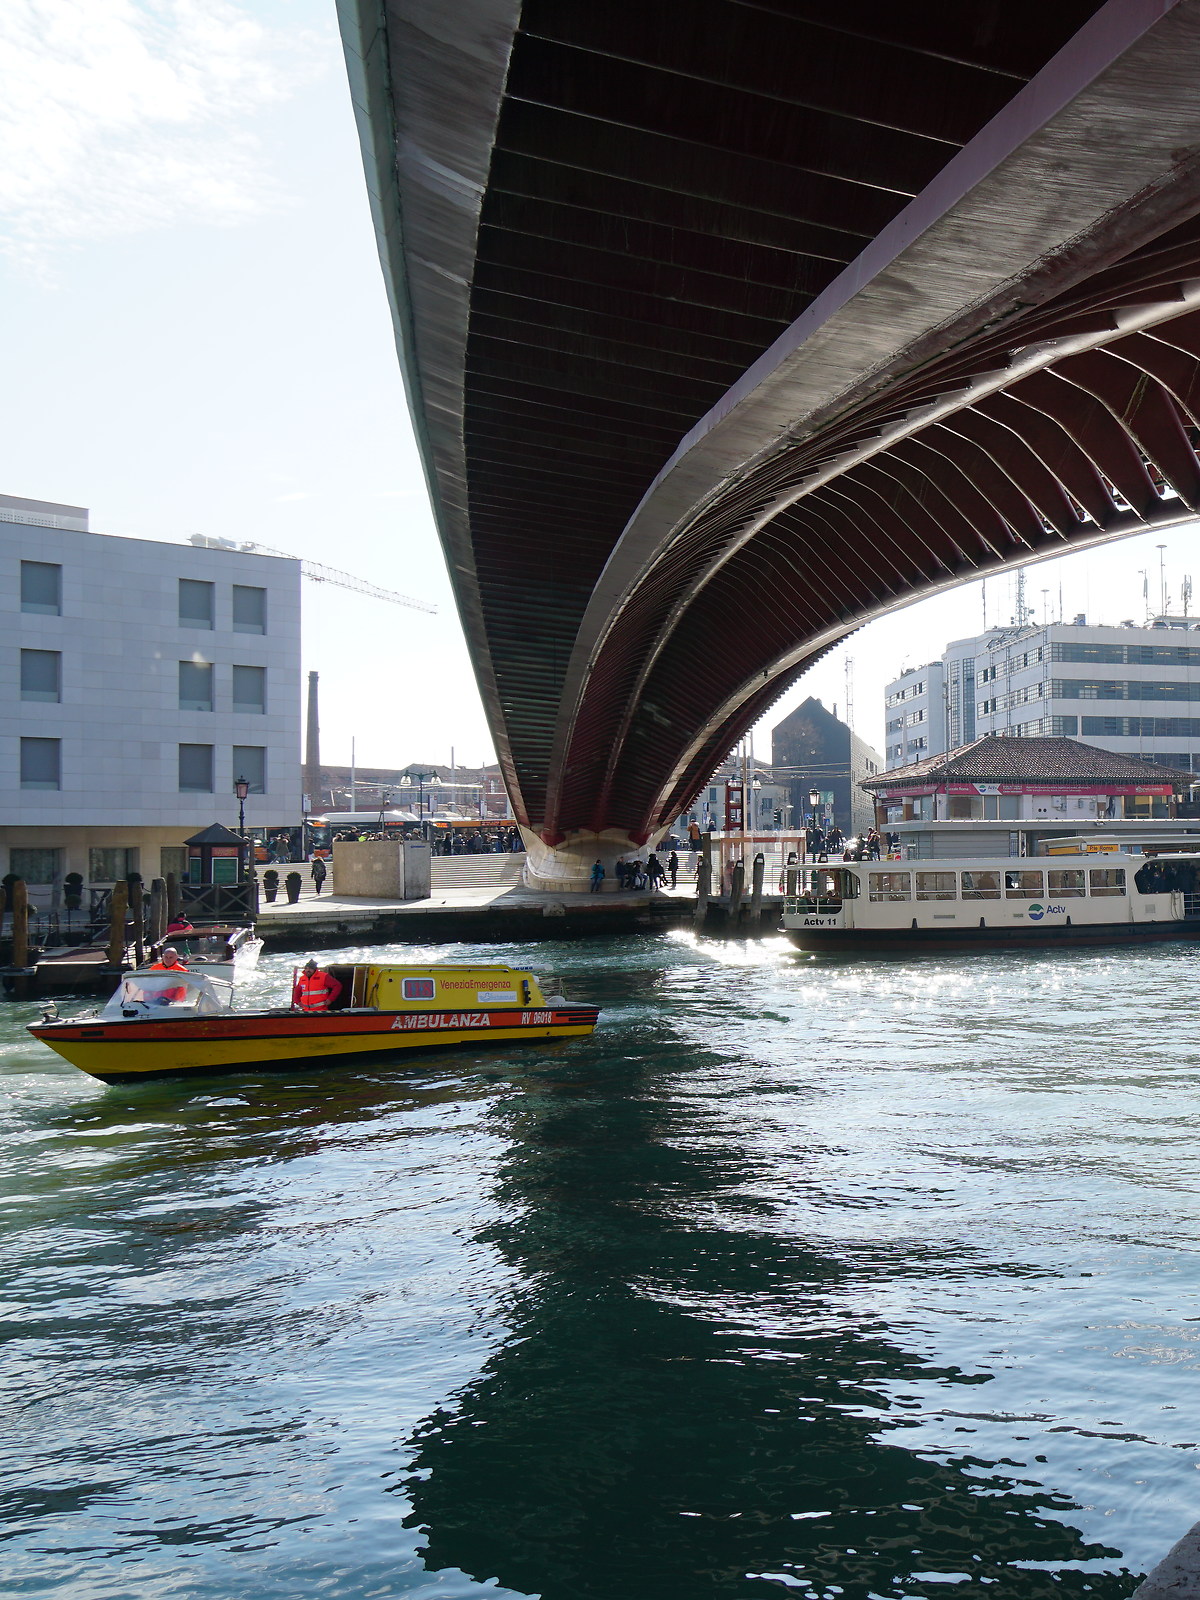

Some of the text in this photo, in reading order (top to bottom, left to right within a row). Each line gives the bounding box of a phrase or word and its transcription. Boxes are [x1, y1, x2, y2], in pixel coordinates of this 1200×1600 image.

[1046, 905, 1066, 914] Actv
[803, 918, 837, 926] Actv 11
[405, 982, 433, 998] 118
[440, 980, 511, 991] VeneziaEmergenza
[391, 1013, 491, 1030] AMBULANZA
[521, 1012, 532, 1025] RV
